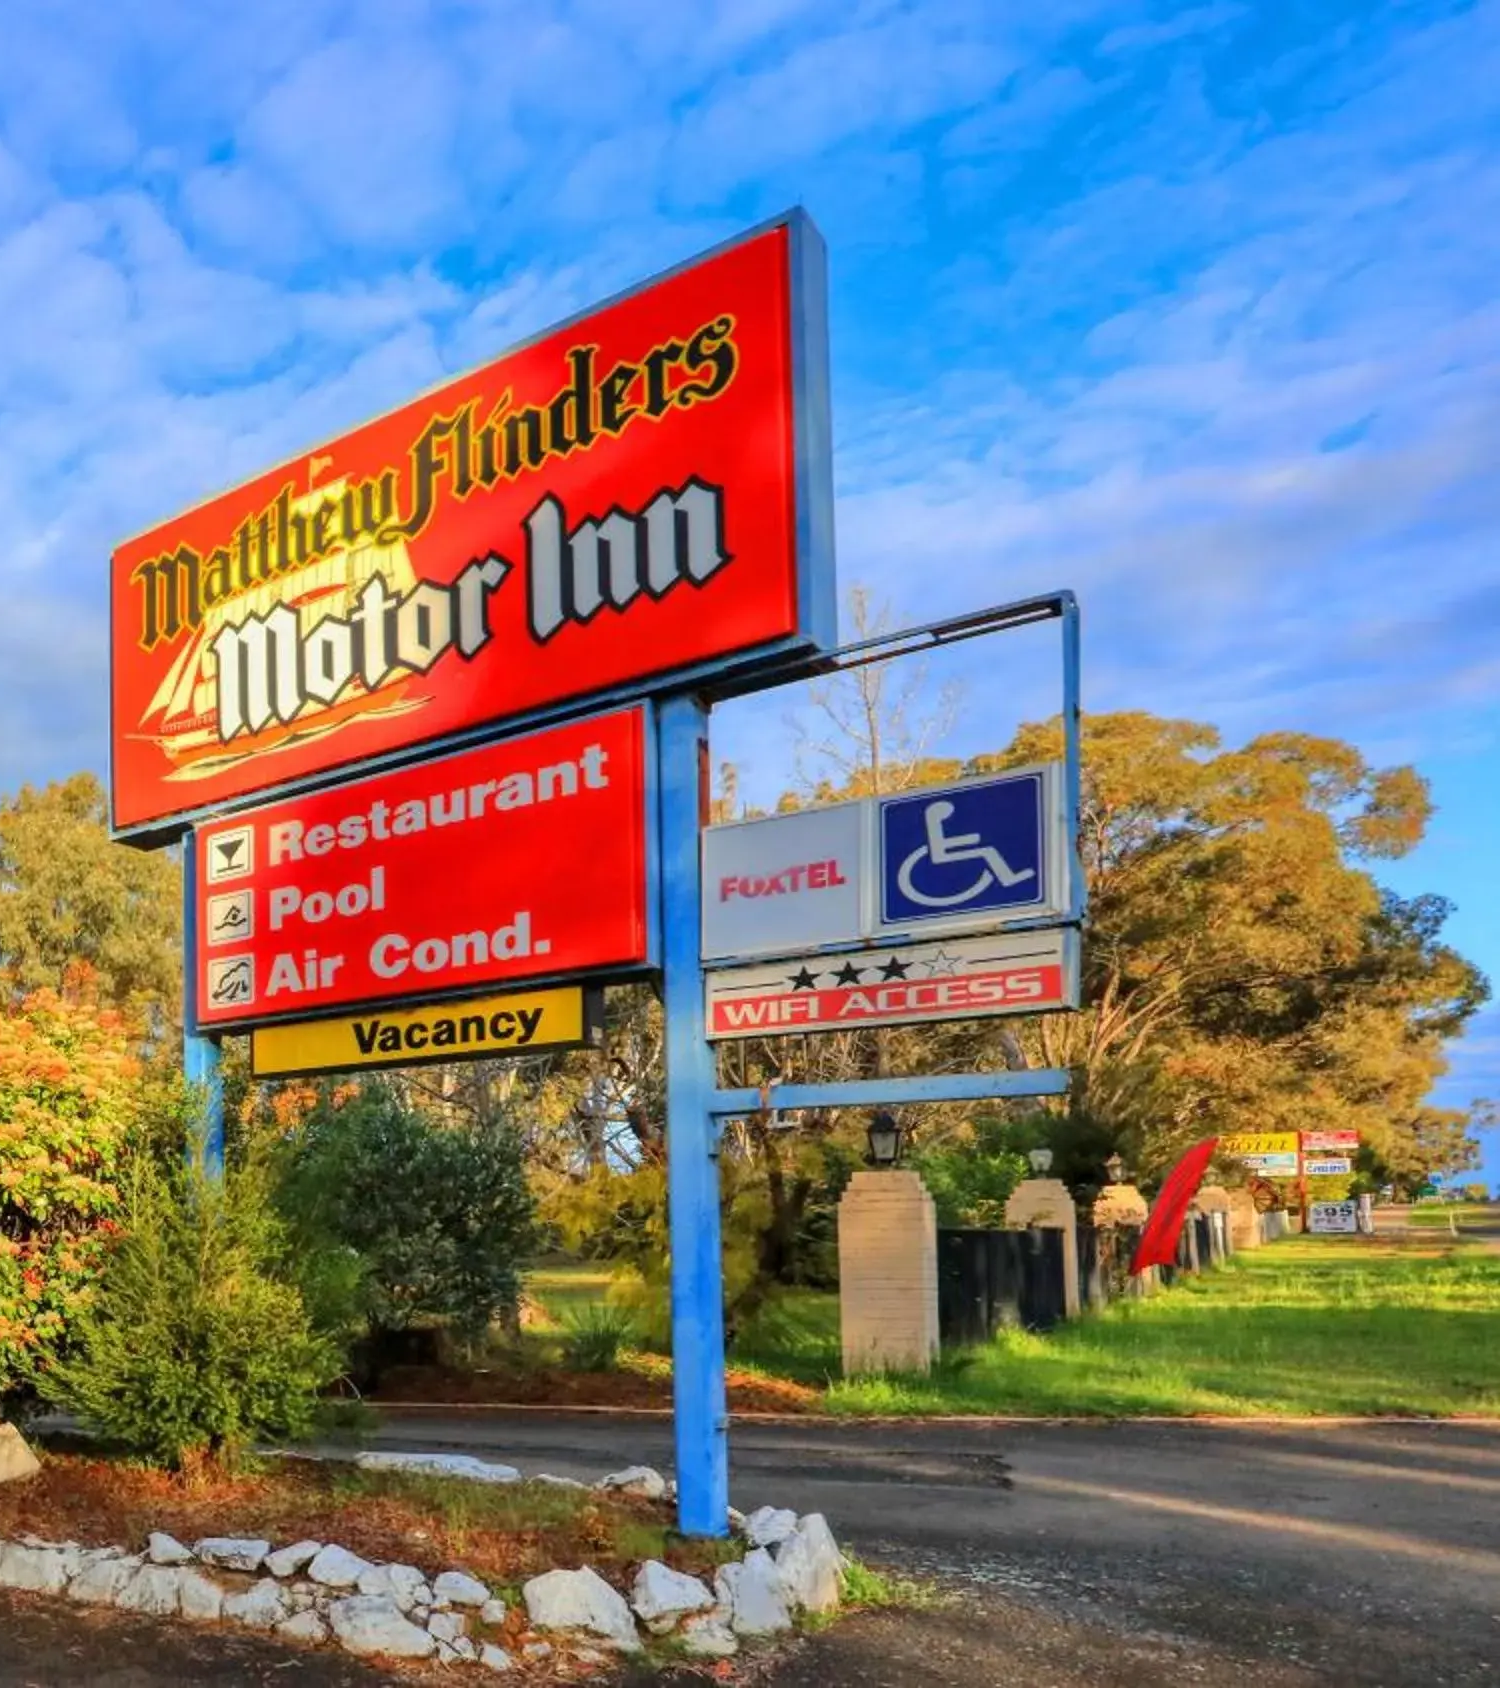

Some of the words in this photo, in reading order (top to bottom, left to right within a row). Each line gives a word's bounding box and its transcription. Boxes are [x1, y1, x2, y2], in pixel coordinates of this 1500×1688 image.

[131, 466, 403, 654] Matthew
[376, 313, 738, 547] Flinders
[207, 550, 512, 745] Motor
[523, 474, 735, 646] Inn
[269, 744, 609, 866] Restaurant
[269, 867, 385, 931] Pool
[719, 860, 846, 902] FOXTEL
[265, 949, 344, 997] Air
[369, 912, 552, 978] Cond.
[352, 1007, 544, 1055] Vacancy
[722, 997, 820, 1027] WIFI
[839, 972, 1043, 1016] ACCESS
